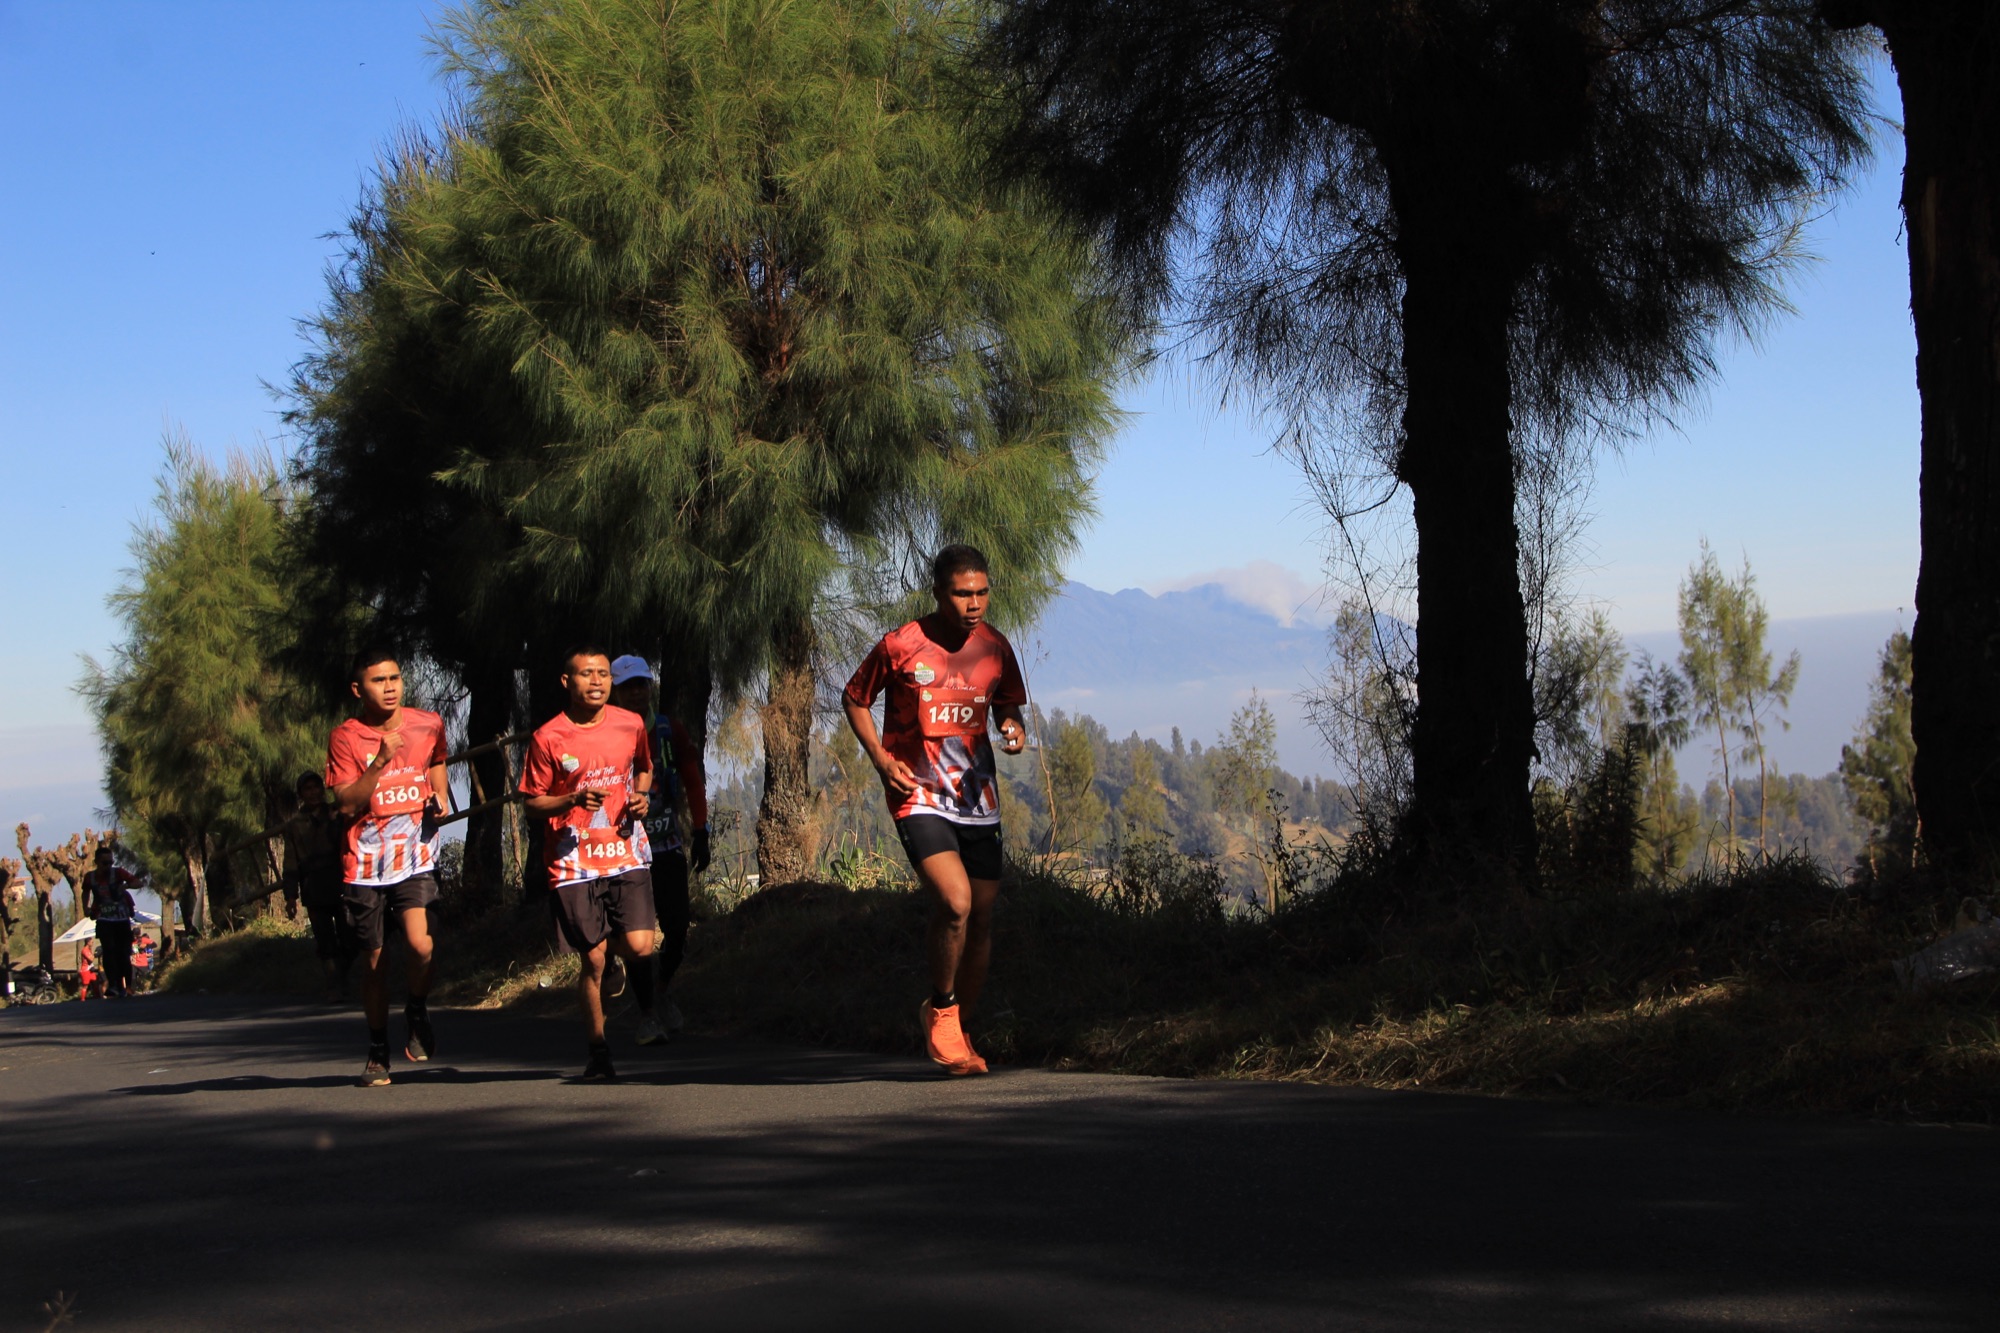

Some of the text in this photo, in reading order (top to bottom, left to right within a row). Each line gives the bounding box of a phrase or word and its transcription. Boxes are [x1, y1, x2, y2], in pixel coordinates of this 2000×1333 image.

[929, 706, 974, 723] 1419
[586, 766, 616, 777] RUN THE
[576, 775, 626, 791] ADVENTURE!
[376, 786, 420, 805] 1360
[585, 841, 626, 858] 1488
